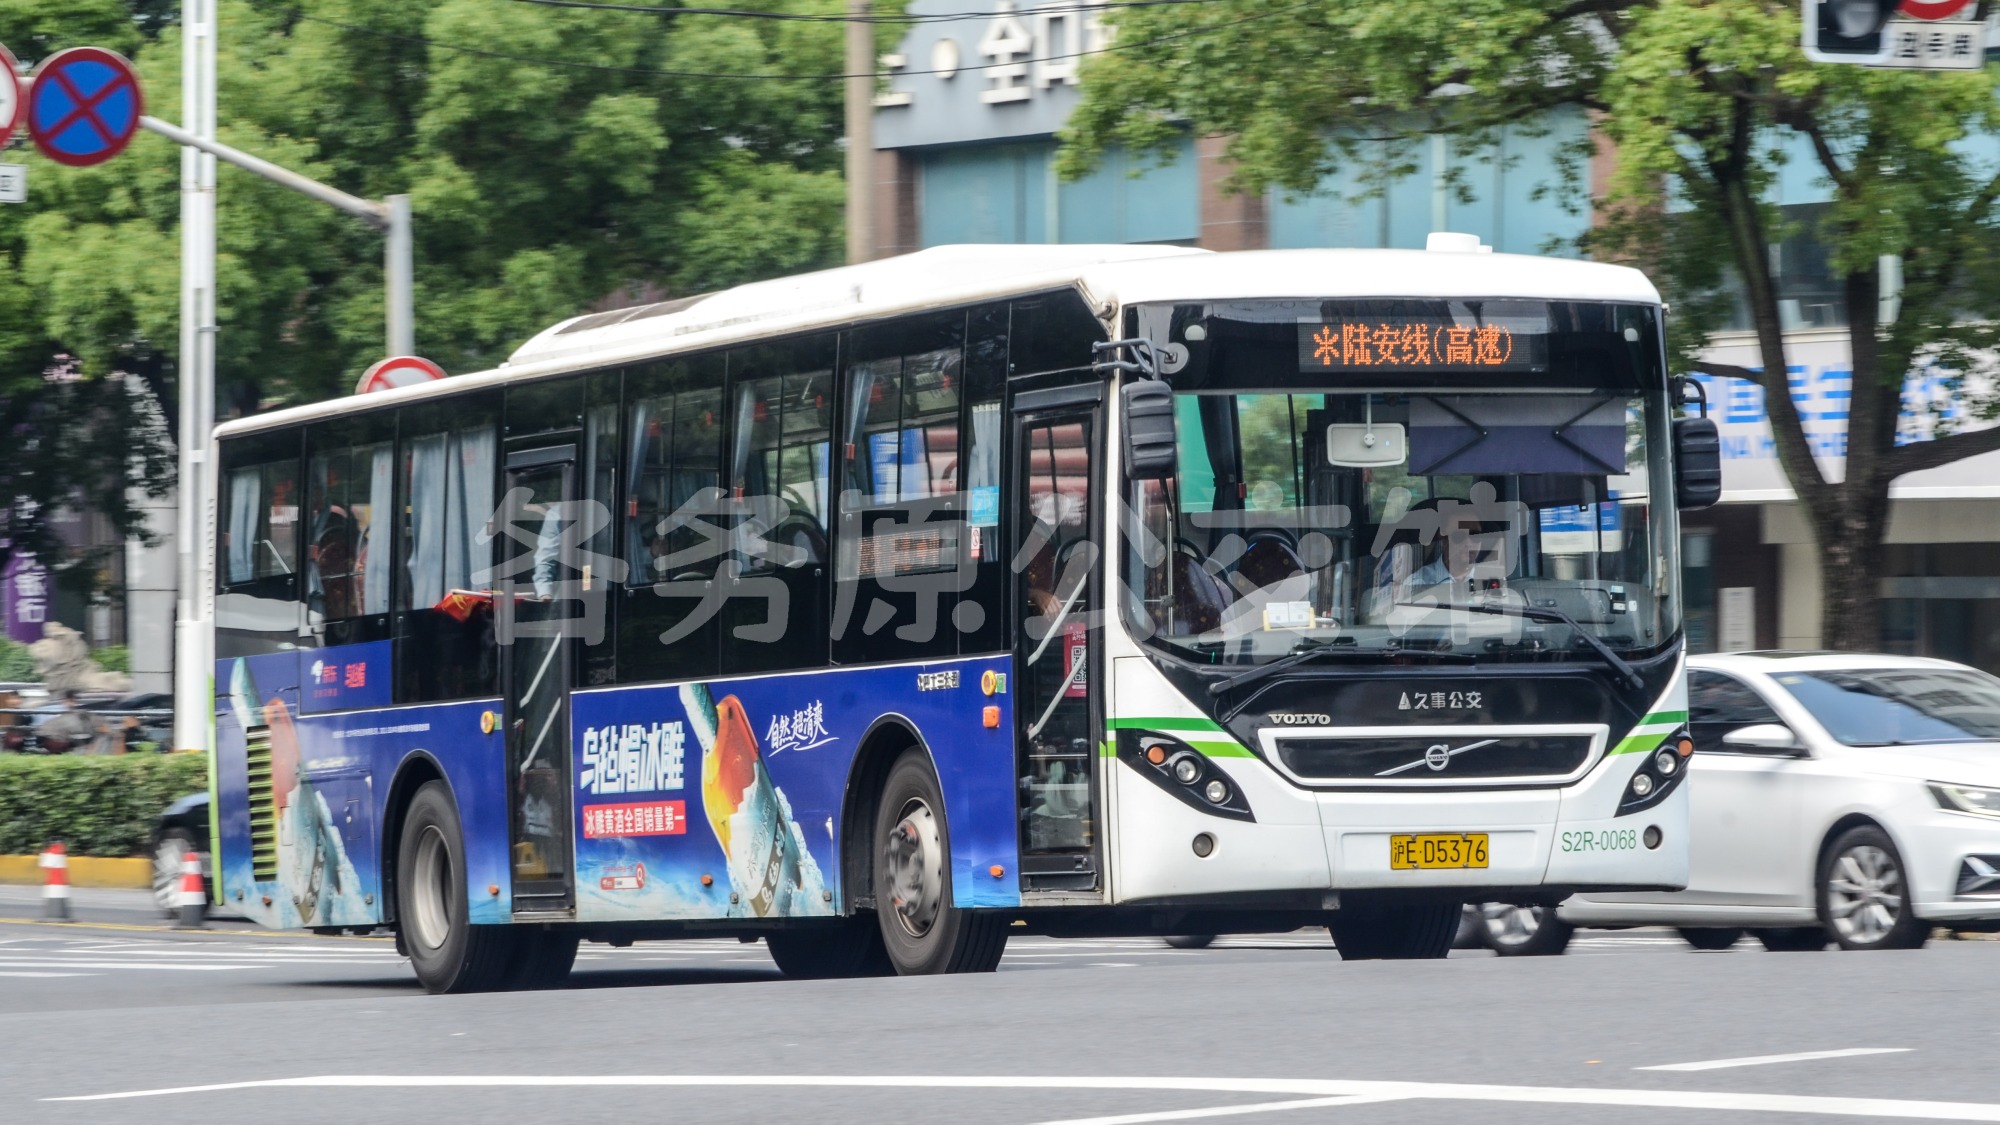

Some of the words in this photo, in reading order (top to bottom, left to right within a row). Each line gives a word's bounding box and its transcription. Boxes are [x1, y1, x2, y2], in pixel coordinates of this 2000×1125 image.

[1414, 691, 1482, 710] 久事公交
[765, 699, 828, 750] 自然超清爽
[1268, 713, 1331, 725] VOLVO
[580, 721, 686, 795] 乌毡帽冰雕
[585, 806, 685, 835] 冰雕黄酒全国销量第一
[1394, 840, 1487, 864] 沪E·D5376
[1561, 829, 1637, 852] S2R-0068
